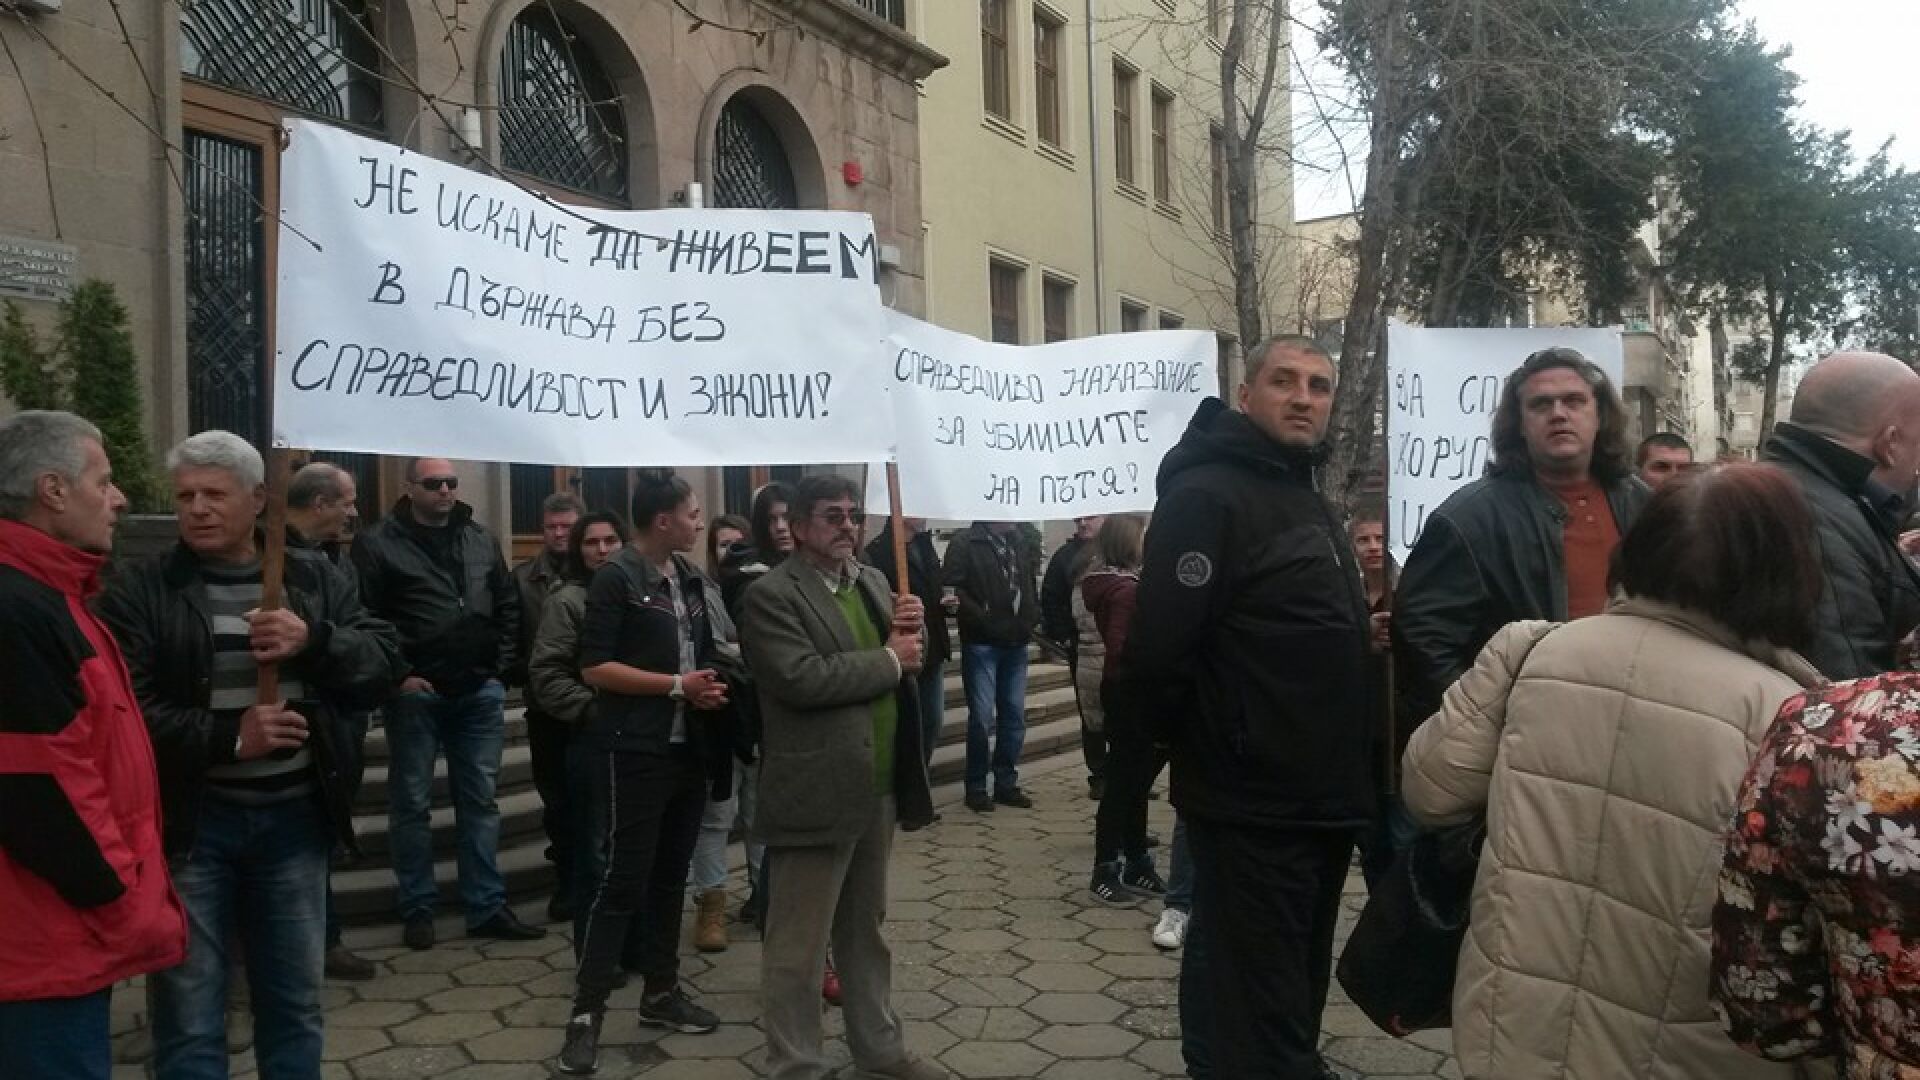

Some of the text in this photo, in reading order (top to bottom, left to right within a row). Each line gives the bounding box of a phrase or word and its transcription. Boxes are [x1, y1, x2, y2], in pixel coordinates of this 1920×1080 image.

[354, 156, 880, 284] НЕ ИСКАМЕ ДА ЖИВЕЕМ
[368, 261, 726, 343] В ДЪРЖАВА БЕЗ
[291, 339, 832, 421] СПРАВЕДЛИВОСТ И ЗАКОНИ!
[895, 348, 1203, 404] СПРАВЕДЛИВО НАКАЗАНИЕ
[1459, 375, 1499, 416] СП
[935, 416, 965, 446] ЗА
[1395, 432, 1490, 480] КОРУП
[984, 462, 1139, 506] НА ПЪТЯ!
